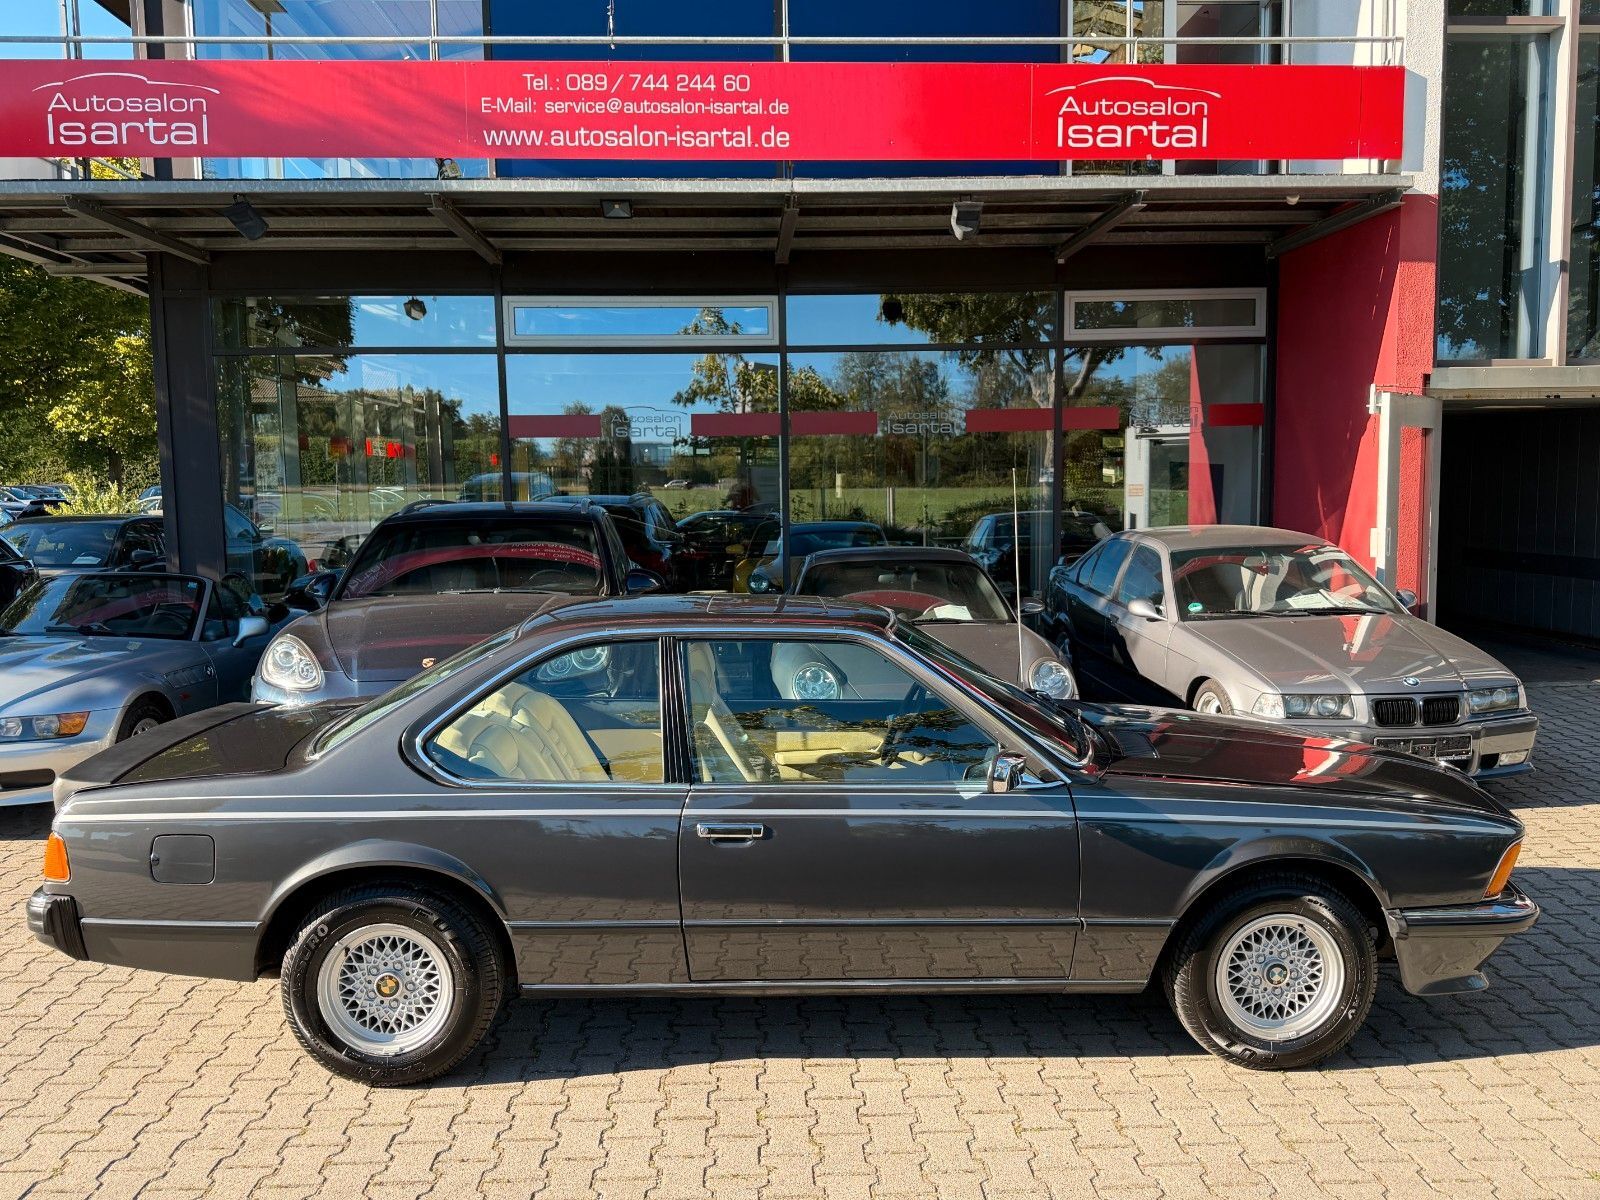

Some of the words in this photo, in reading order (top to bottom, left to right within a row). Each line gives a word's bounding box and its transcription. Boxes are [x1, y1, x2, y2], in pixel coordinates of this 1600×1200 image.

[566, 73, 608, 91] 089
[629, 73, 669, 92] 744
[676, 73, 716, 92] 244
[723, 74, 750, 92] 60
[47, 92, 207, 112] Autosalon
[481, 97, 537, 113] E-Mail:
[544, 97, 789, 115] service@autosalon-isartal.de
[1058, 96, 1208, 116] Autosalon
[47, 113, 209, 145] Isartal
[483, 124, 790, 148] www.autosalon-isartal.de
[1057, 116, 1208, 148] Isartal
[611, 413, 682, 423] Autosalon
[611, 422, 682, 438] Isartal
